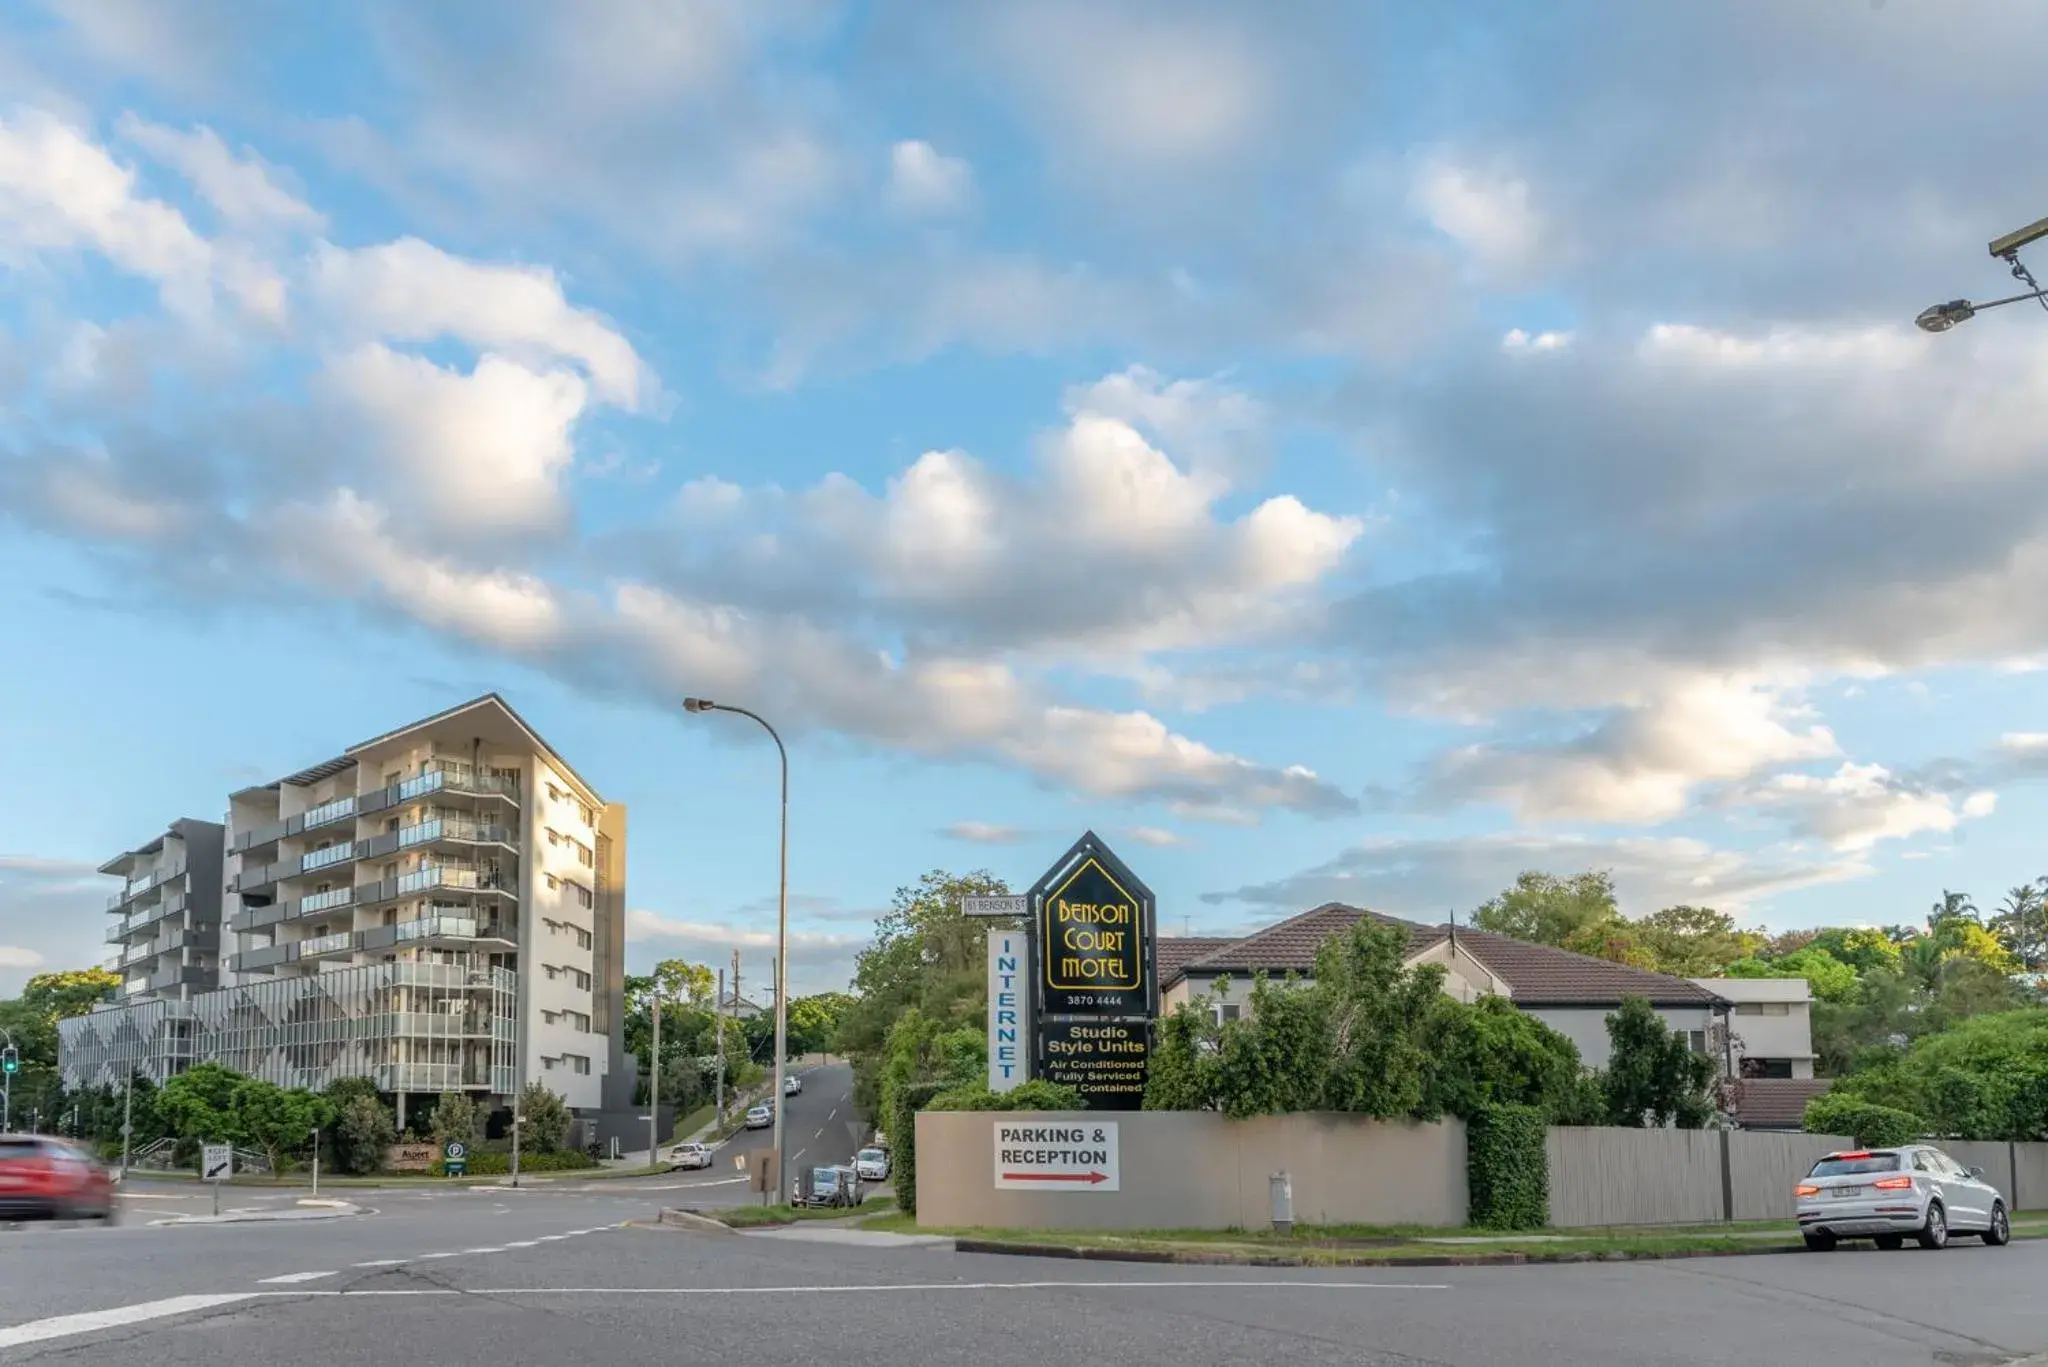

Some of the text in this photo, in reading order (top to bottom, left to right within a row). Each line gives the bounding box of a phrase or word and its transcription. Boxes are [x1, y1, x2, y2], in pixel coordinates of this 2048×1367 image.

[978, 900, 1012, 911] BENSON
[1064, 927, 1125, 951] COURT
[1062, 958, 1129, 978] MOTEL
[1067, 995, 1122, 1005] 3870 4444
[998, 939, 1016, 1078] INTERNET
[1069, 1026, 1129, 1039] Studio
[1047, 1040, 1145, 1056] Style Units
[1049, 1060, 1145, 1069] Air Conditioned
[1054, 1071, 1141, 1082] Fully Serviced
[1080, 1083, 1143, 1093] Contained
[1000, 1128, 1106, 1143] PARKING &
[1001, 1149, 1107, 1165] RECEPTION
